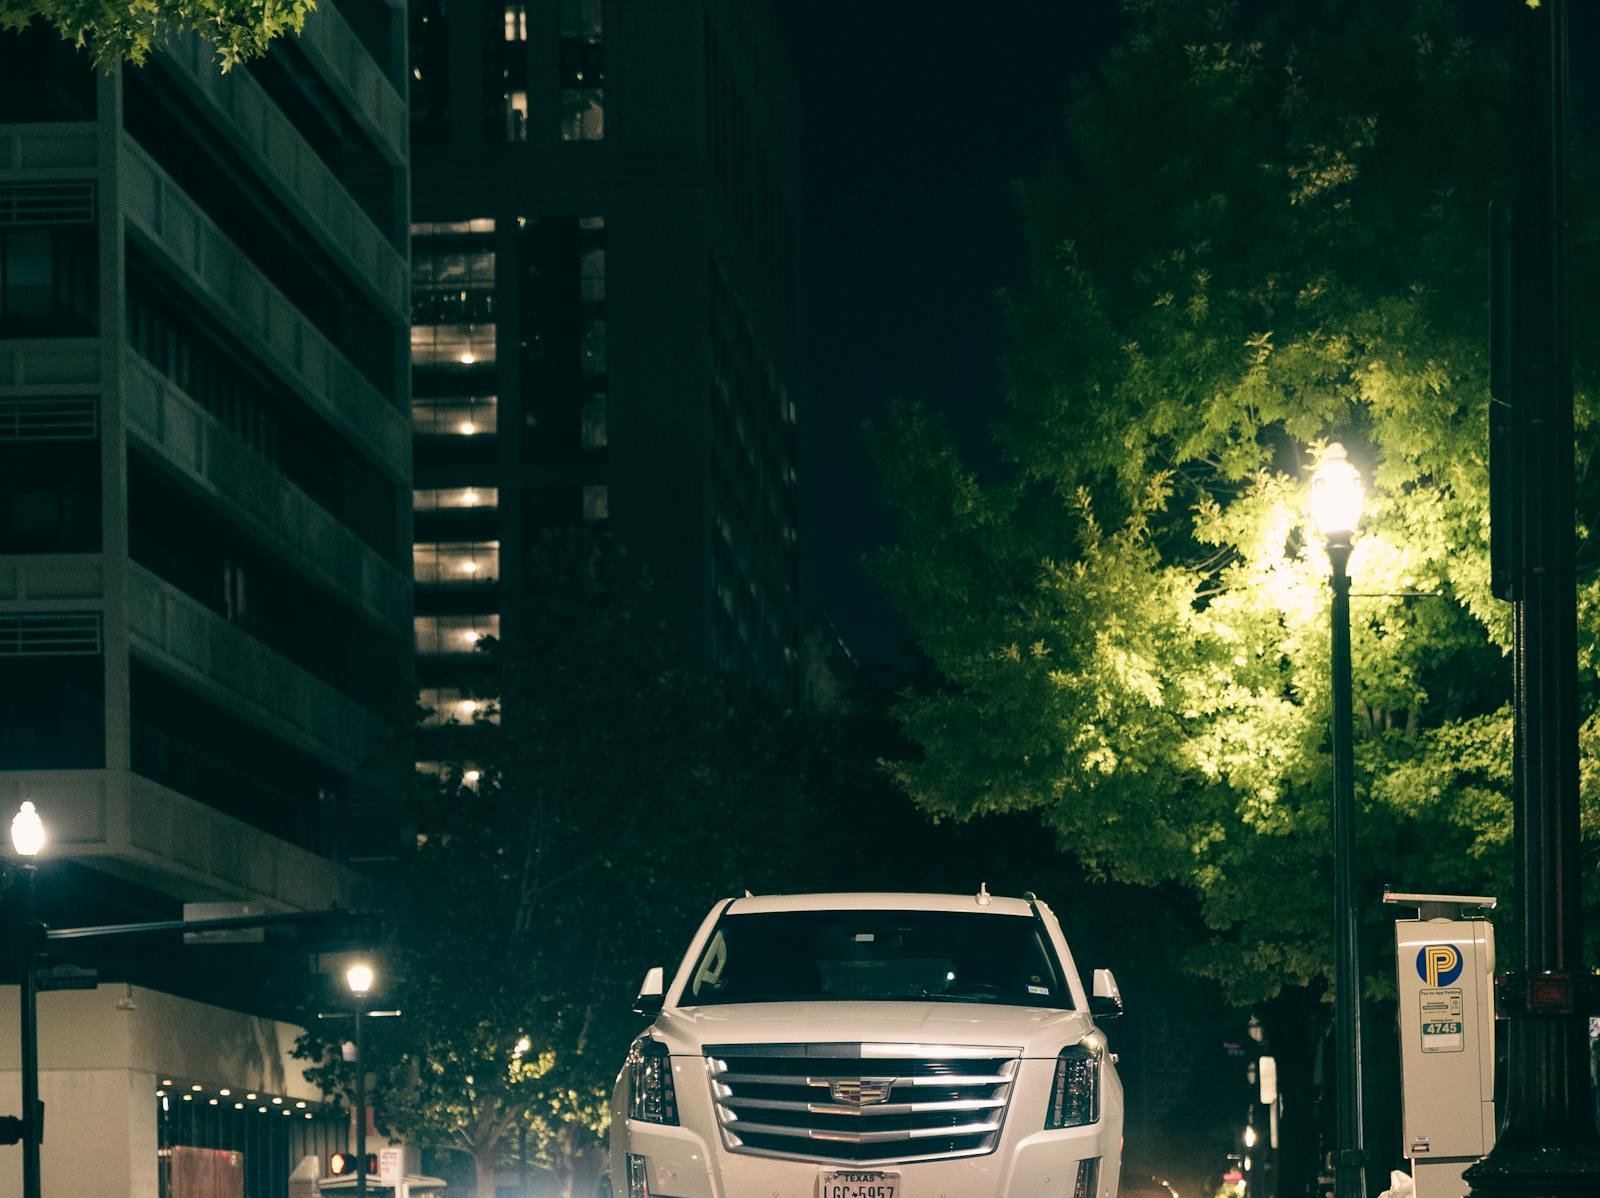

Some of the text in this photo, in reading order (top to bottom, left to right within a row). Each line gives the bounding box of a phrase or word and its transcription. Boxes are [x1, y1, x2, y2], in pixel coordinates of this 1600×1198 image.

[1425, 946, 1458, 987] P
[1427, 1023, 1457, 1034] 4745
[844, 1174, 876, 1183] TEXAS
